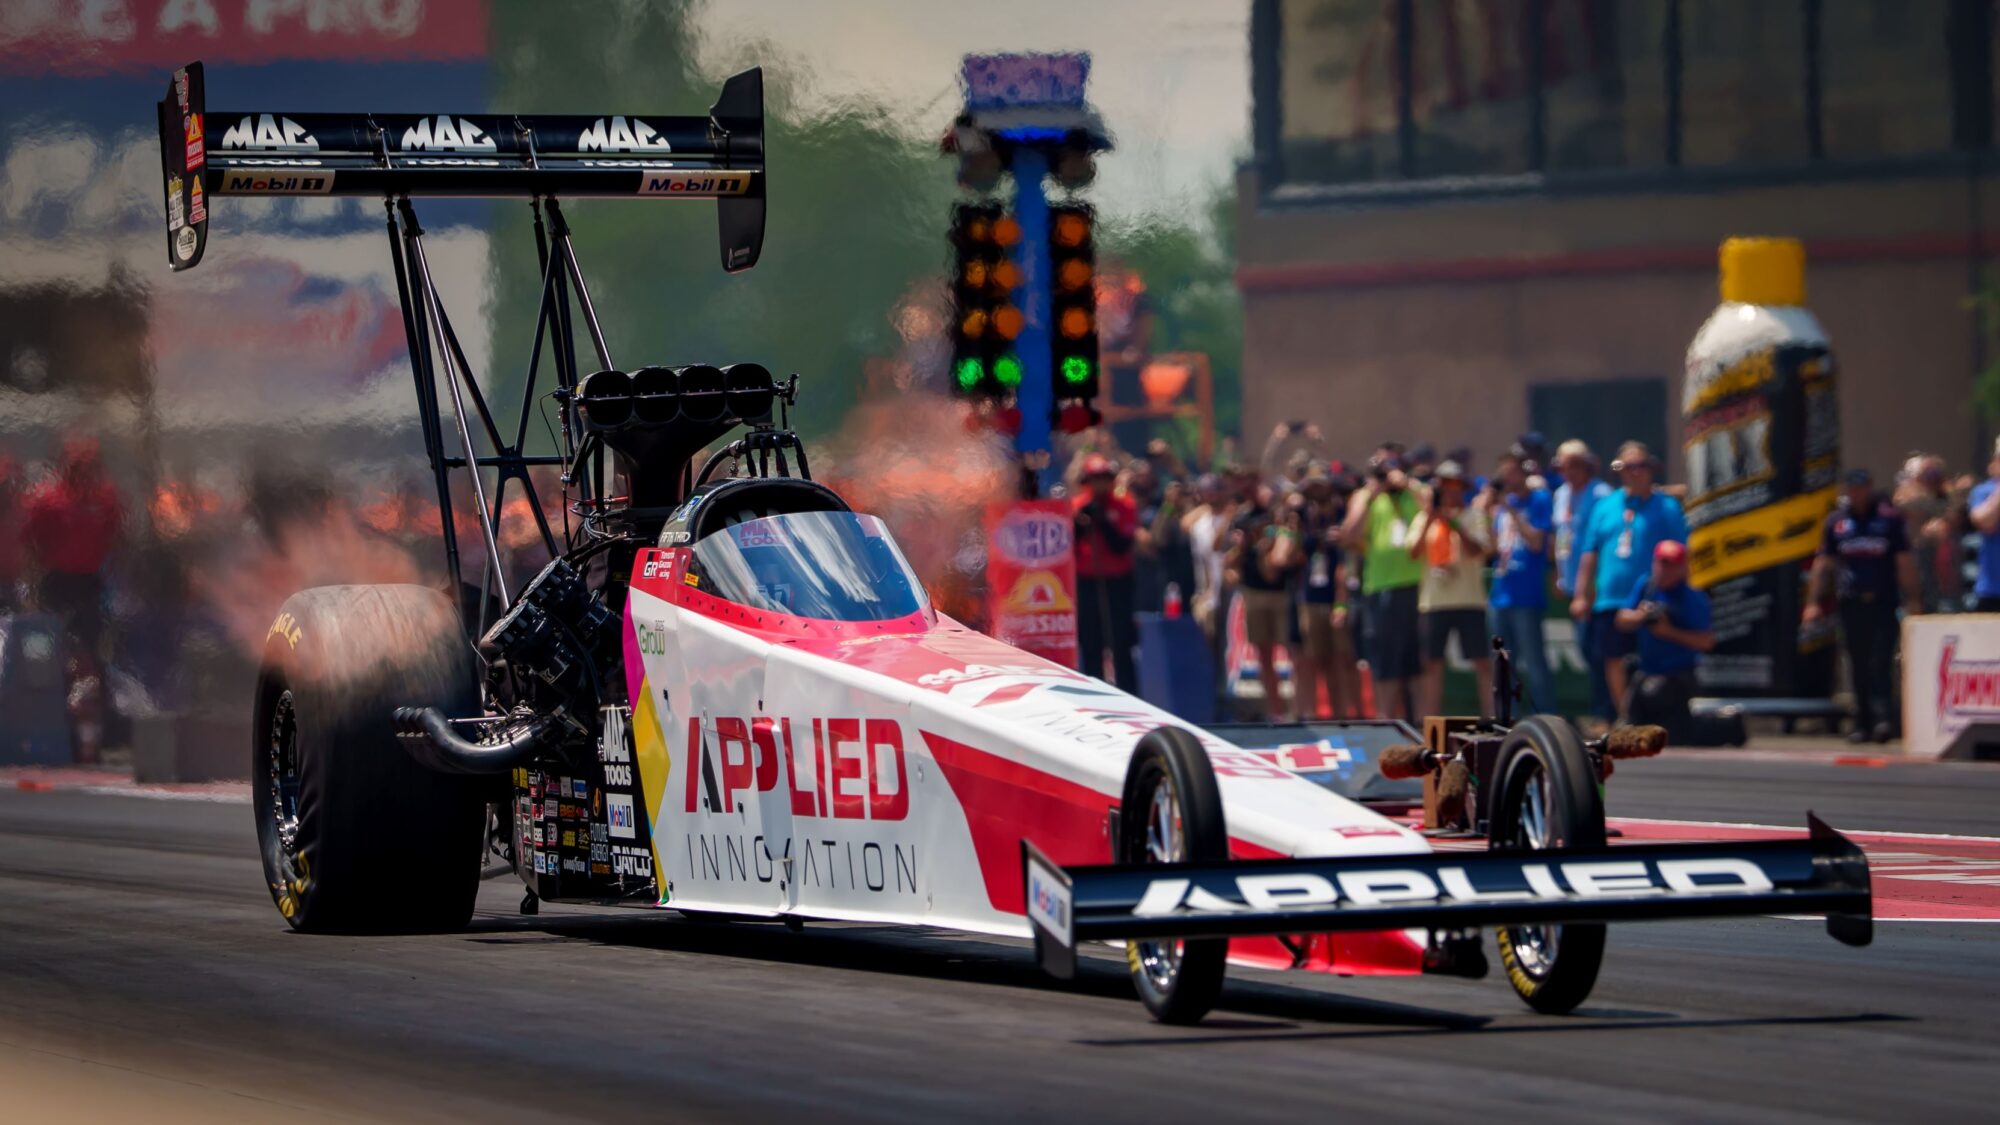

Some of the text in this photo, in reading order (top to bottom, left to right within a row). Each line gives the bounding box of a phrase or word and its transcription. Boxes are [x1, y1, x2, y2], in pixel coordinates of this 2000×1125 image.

[221, 113, 320, 151] MAC
[401, 115, 498, 153] MAC
[577, 115, 672, 153] MAC
[229, 176, 324, 191] Mobil 1
[648, 178, 741, 192] Mobil 1
[643, 561, 659, 577] GR
[639, 623, 665, 656] Grow
[603, 704, 631, 762] MAC
[604, 764, 633, 787] TOOLS
[685, 716, 909, 822] APPLIED
[609, 803, 626, 828] Mobil
[590, 822, 609, 843] FUTURE
[591, 842, 610, 863] ENERGY
[611, 845, 653, 878] DAYCO
[686, 834, 917, 894] INNOVATION
[1132, 858, 1774, 916] APPLIED
